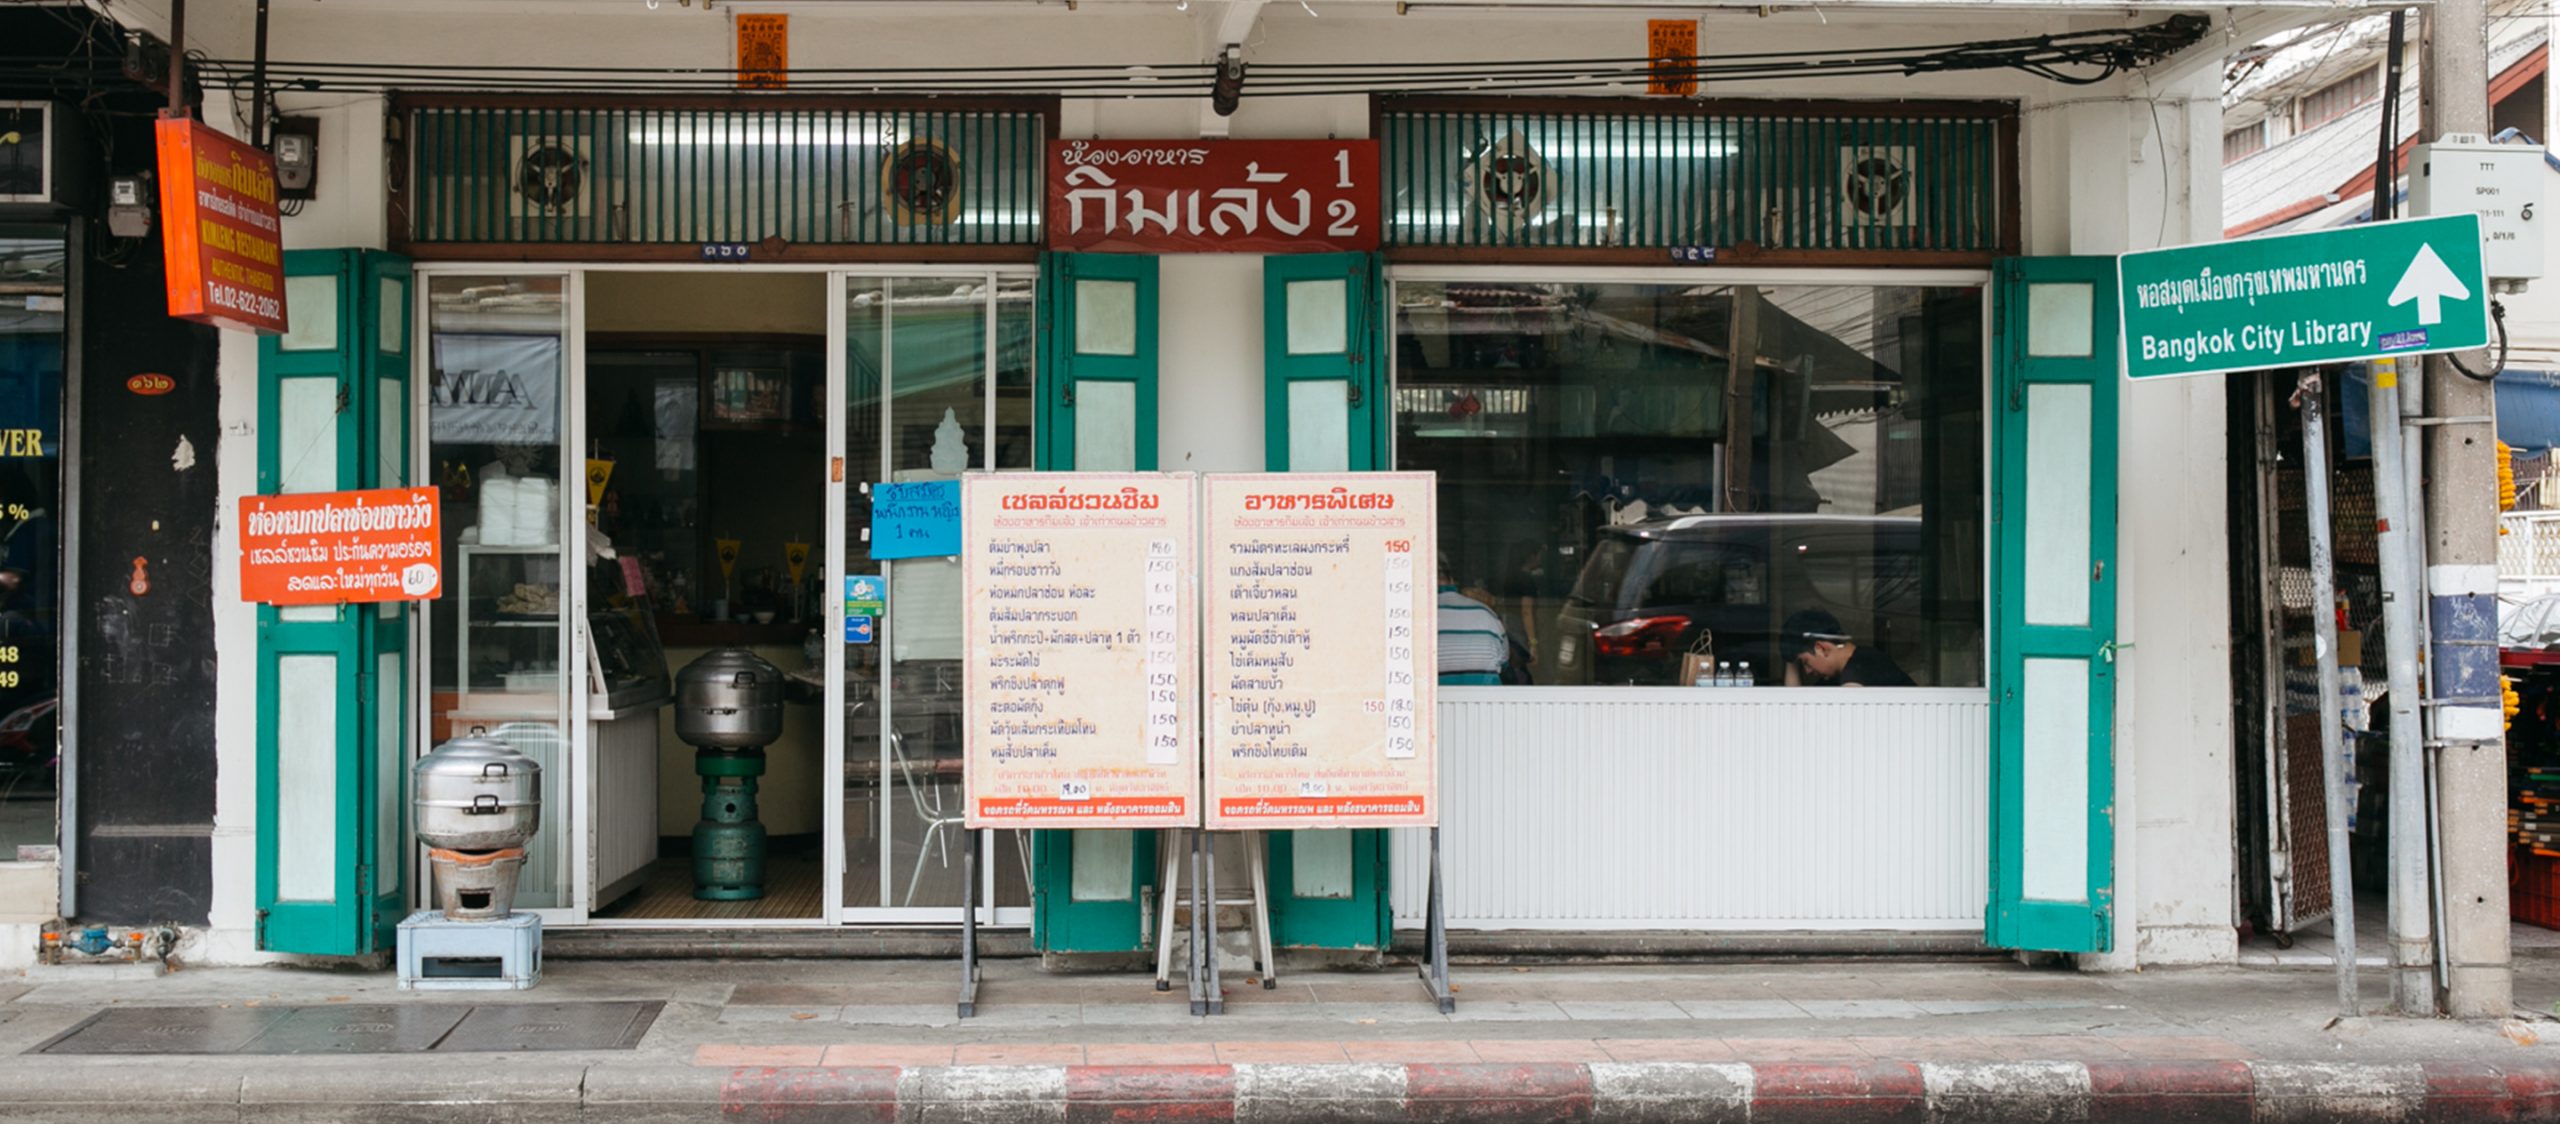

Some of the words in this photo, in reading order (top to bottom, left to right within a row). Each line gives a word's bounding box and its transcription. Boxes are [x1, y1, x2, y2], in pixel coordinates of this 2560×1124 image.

[1062, 140, 1209, 165] ห้องอาหาร
[1333, 149, 1354, 188] 1
[1064, 161, 1312, 236] กิมเล้ง
[1328, 199, 1359, 236] 2
[236, 229, 278, 267] RESTAURANT
[2137, 258, 2366, 314] หอสมุดเมืองกรุงเทพมหานคร
[2142, 327, 2236, 362] Bangkok
[2241, 323, 2285, 354] City
[2292, 319, 2373, 347] Library
[1002, 486, 1160, 510] เชลล์ชวนชิม
[1245, 486, 1395, 511] อาหารพิเศษ
[248, 493, 432, 536] ห่อหมกปลาช่อนชาววัง
[896, 523, 903, 539] 1
[250, 538, 328, 565] เชลล์ชวนชิม
[333, 534, 432, 562] ประกันความอร่อย
[989, 538, 1050, 558] ต้มยำพุงปลา
[1384, 540, 1410, 553] 150
[989, 557, 1061, 577] หมี่กรอบชาววัง
[1148, 560, 1175, 573] 150
[1230, 561, 1312, 577] แกงส้มปลาช่อน
[287, 564, 400, 595] สดและใหม่ทุกวัน
[408, 570, 425, 586] 60
[989, 586, 1065, 600] ห่อหมกปลาช่อน
[1069, 585, 1096, 600] ห่อละ
[1230, 579, 1297, 600] เต้าเจี้ยวหลน
[1388, 582, 1411, 594] 150
[989, 606, 1077, 622] ต้มส้มปลากระบอก
[1149, 605, 1175, 617] 150
[1230, 606, 1297, 622] หลนปลาเค็ม
[1388, 608, 1411, 620] 150
[1117, 632, 1124, 644] 1
[1127, 628, 1141, 644] ตัว
[1149, 631, 1176, 644] 150
[1388, 626, 1410, 640] 150
[990, 650, 1040, 667] มะระผัดไข่
[1150, 651, 1176, 664] 150
[1229, 651, 1294, 672] ไข่เค็มหมูสับ
[1389, 648, 1410, 660] 150
[990, 674, 1065, 696] พริกขิงปลาดุกฟู
[1150, 673, 1178, 686] 150
[1231, 674, 1283, 690] ผัดสายบัว
[1387, 672, 1412, 685] 150
[1151, 689, 1177, 702] 150
[990, 697, 1043, 718] สะตอผัดกุ้ง
[1365, 701, 1385, 713] 150
[1152, 713, 1178, 725] 150
[1387, 716, 1412, 729] 150
[990, 717, 1096, 741] ผัดวุ้นเส้นกระเทียมโทน
[1231, 720, 1291, 740] ยำปลาทูน่า
[1154, 735, 1178, 748] 150
[1388, 738, 1414, 751] 150
[990, 741, 1057, 765] หมูสับปลาเค็ม
[1231, 741, 1308, 759] พริกขิงไทยเดิม
[1076, 805, 1094, 815] และ
[1316, 804, 1333, 814] และ
